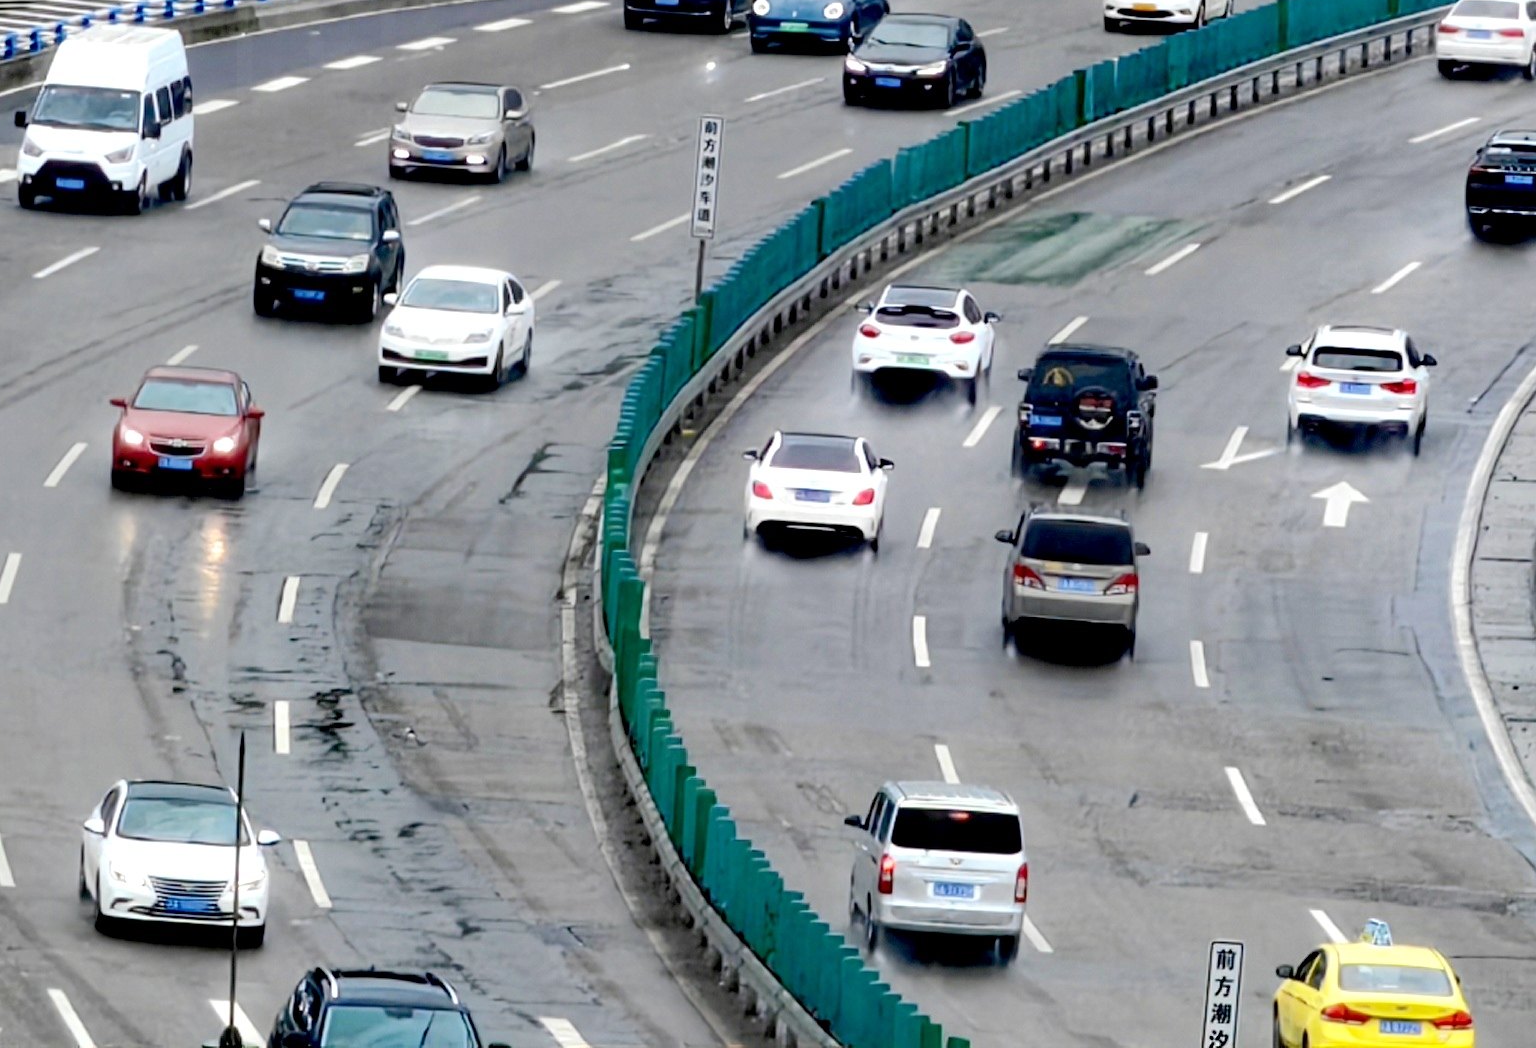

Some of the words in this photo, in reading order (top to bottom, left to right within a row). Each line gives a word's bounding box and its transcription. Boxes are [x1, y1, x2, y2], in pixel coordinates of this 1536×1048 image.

[697, 120, 718, 222] 前方潮汐车道
